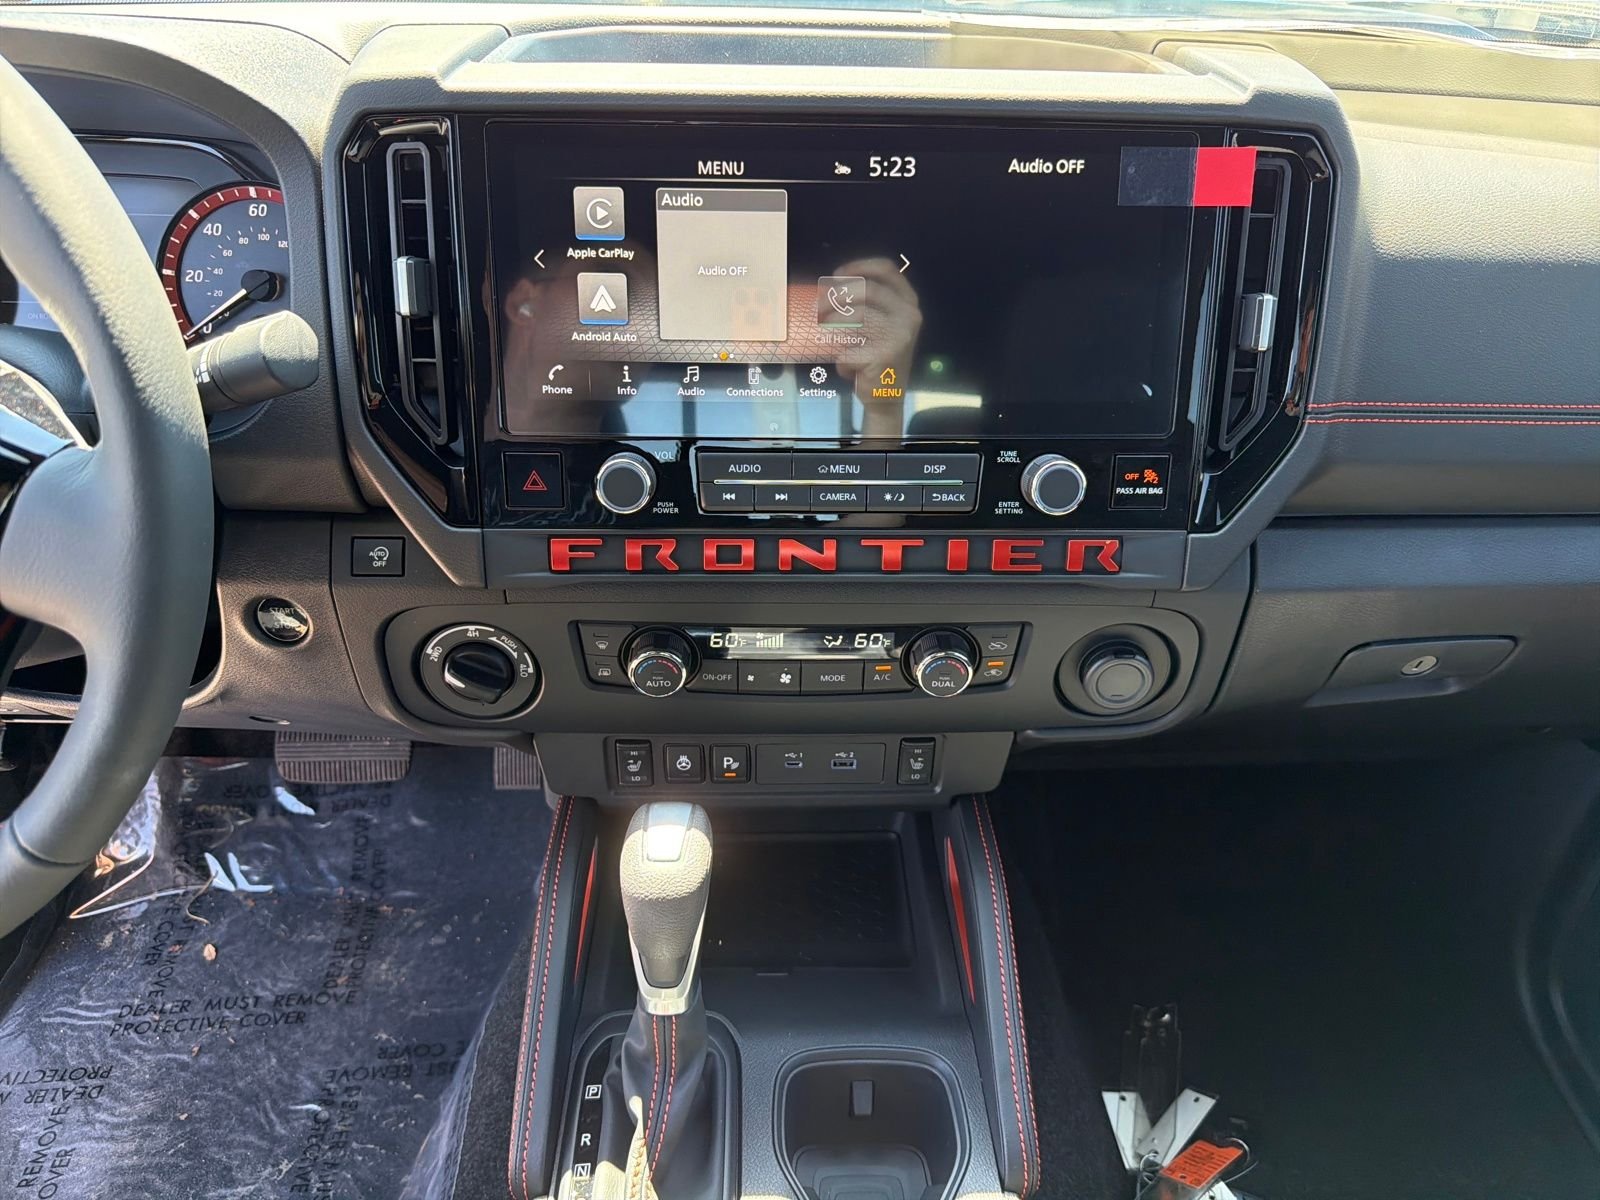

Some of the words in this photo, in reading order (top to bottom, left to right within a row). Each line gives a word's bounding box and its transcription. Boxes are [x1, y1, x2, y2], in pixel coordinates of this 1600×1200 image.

[698, 160, 745, 176] MENU
[869, 156, 917, 177] 5:23
[1008, 158, 1053, 174] Audio
[1056, 159, 1085, 174] OFF
[661, 193, 703, 207] Audio
[248, 203, 268, 217] 60
[203, 223, 222, 236] 40
[238, 237, 249, 245] 80
[257, 233, 271, 241] 100
[222, 249, 233, 257] 60
[567, 247, 596, 259] Apple
[598, 247, 635, 260] CarPlay
[185, 270, 203, 282] 20
[213, 267, 223, 275] 40
[698, 265, 727, 276] Audio
[728, 266, 748, 276] OFF
[571, 331, 611, 342] Android
[612, 332, 637, 343] Auto
[814, 334, 832, 345] Call
[833, 334, 867, 346] History
[542, 384, 573, 395] Phone
[617, 385, 637, 396] Info
[677, 386, 706, 397] Audio
[726, 387, 784, 397] Connections
[799, 387, 837, 398] Settings
[872, 388, 902, 398] MENU
[654, 450, 675, 460] VOL
[997, 456, 1021, 464] SCROLL
[728, 463, 762, 474] AUDIO
[829, 464, 861, 475] MENU
[923, 464, 946, 475] DISP
[1124, 473, 1140, 481] OFF
[819, 491, 857, 502] CAMERA
[1116, 487, 1134, 495] PASS
[1134, 487, 1148, 495] AIR
[1148, 487, 1164, 495] BAG
[941, 492, 966, 502] BACK
[652, 507, 679, 515] POWER
[550, 537, 1121, 572] FRONTIER
[466, 630, 480, 638] 4H
[500, 635, 518, 650] PUSH
[429, 646, 443, 662] 2WD
[702, 673, 733, 682] ON-OFF
[820, 674, 846, 682] MODE
[873, 674, 891, 682] A/C
[646, 680, 672, 688] AUTO
[931, 680, 956, 688] DUAL
[143, 920, 175, 966] COVER
[118, 999, 191, 1018] DEALER
[204, 996, 262, 1012] MUST
[274, 989, 358, 1008] REMOVE
[110, 1015, 232, 1037] PROTECTIVE
[239, 1011, 307, 1028] COVER
[376, 1042, 445, 1060] COVER
[324, 1063, 414, 1085] REMOVE
[24, 1085, 105, 1104] DEALER
[588, 1086, 598, 1097] P
[580, 1133, 591, 1146] R
[16, 1106, 71, 1188] REMOVE
[576, 1165, 587, 1177] N
